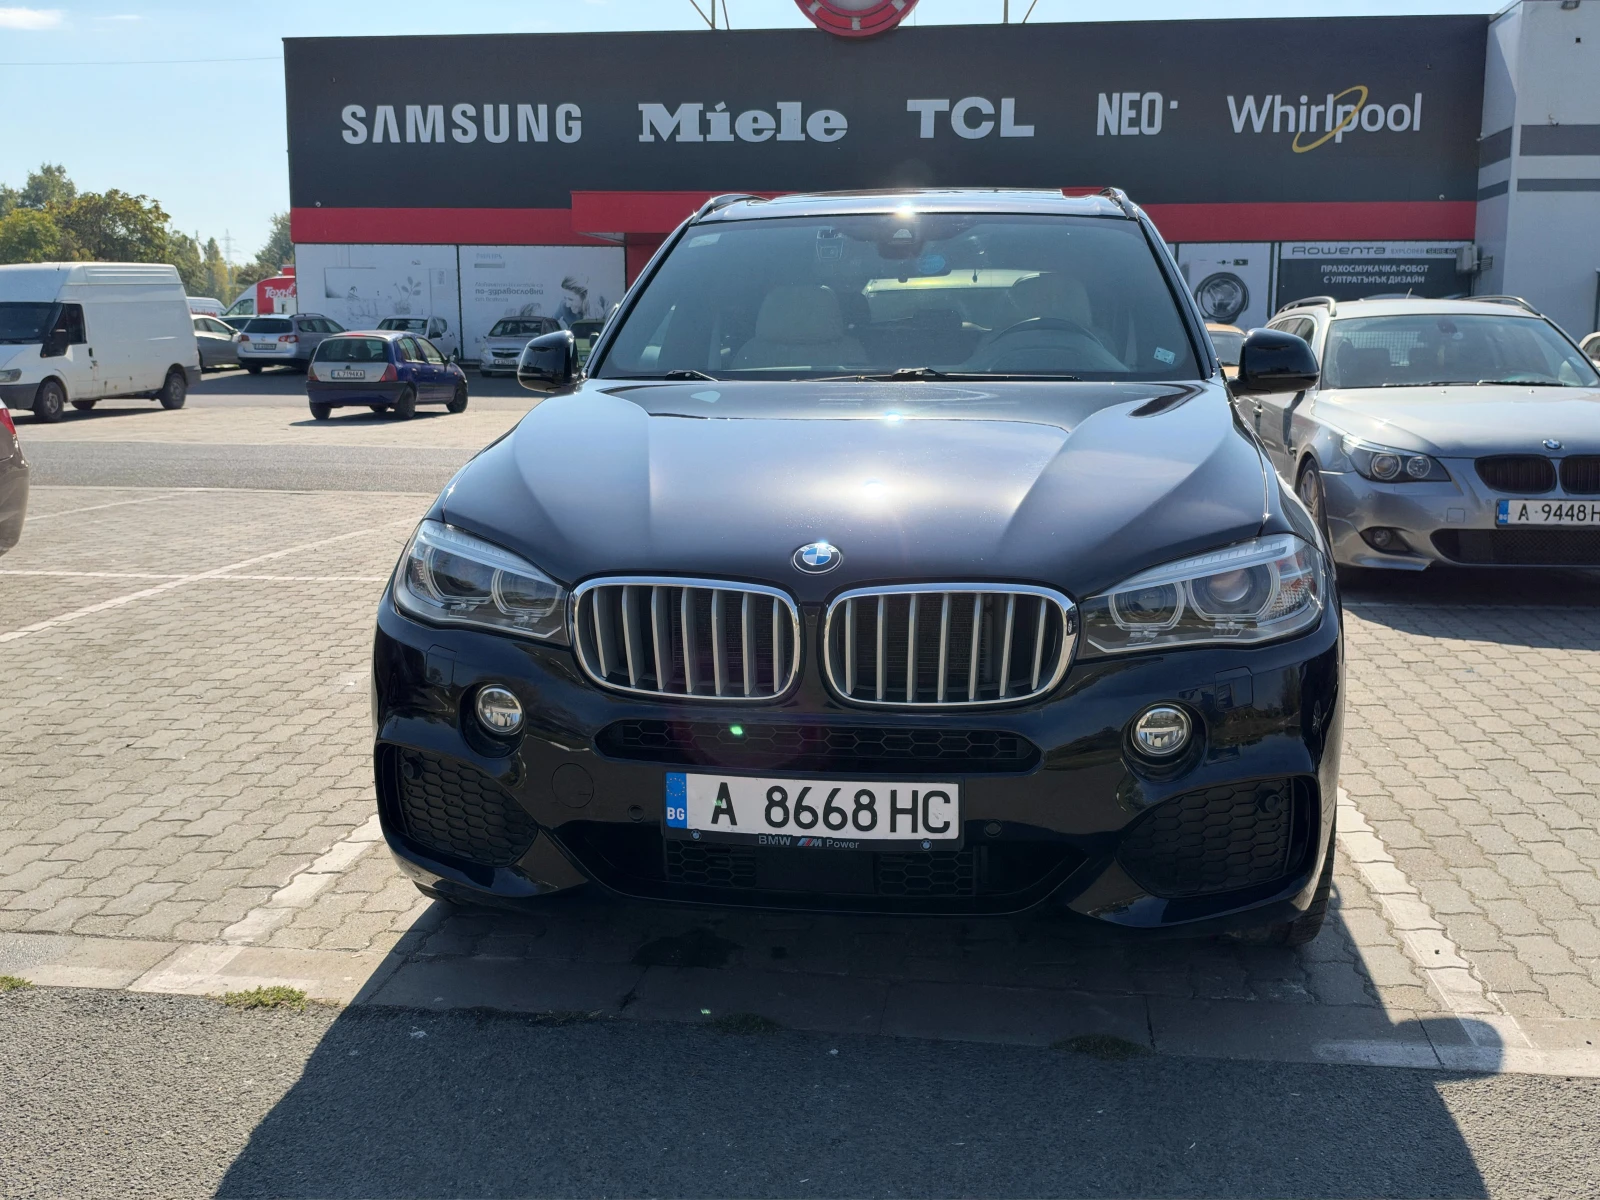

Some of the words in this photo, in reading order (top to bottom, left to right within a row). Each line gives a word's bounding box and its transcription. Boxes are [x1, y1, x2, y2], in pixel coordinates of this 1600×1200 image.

[341, 103, 582, 145] SAMSUNG
[638, 101, 848, 143] Miele
[906, 96, 1035, 138] TCL
[1226, 92, 1422, 144] Whirlpool
[1292, 246, 1386, 255] Rowenta
[1320, 264, 1430, 273] ПРАХОСМУКАЧКА-РОБОТ
[1330, 275, 1387, 284] УЛТРАТЪНЪК
[1388, 275, 1425, 285] ДИЗАЙН
[475, 287, 544, 296] по-здравословни
[1518, 503, 1529, 521] A
[1541, 503, 1587, 522] 9448
[666, 806, 685, 821] BG
[711, 781, 738, 826] A
[764, 785, 878, 832] 8668
[889, 789, 951, 834] HC
[758, 834, 791, 847] BMW
[826, 839, 860, 849] Power
